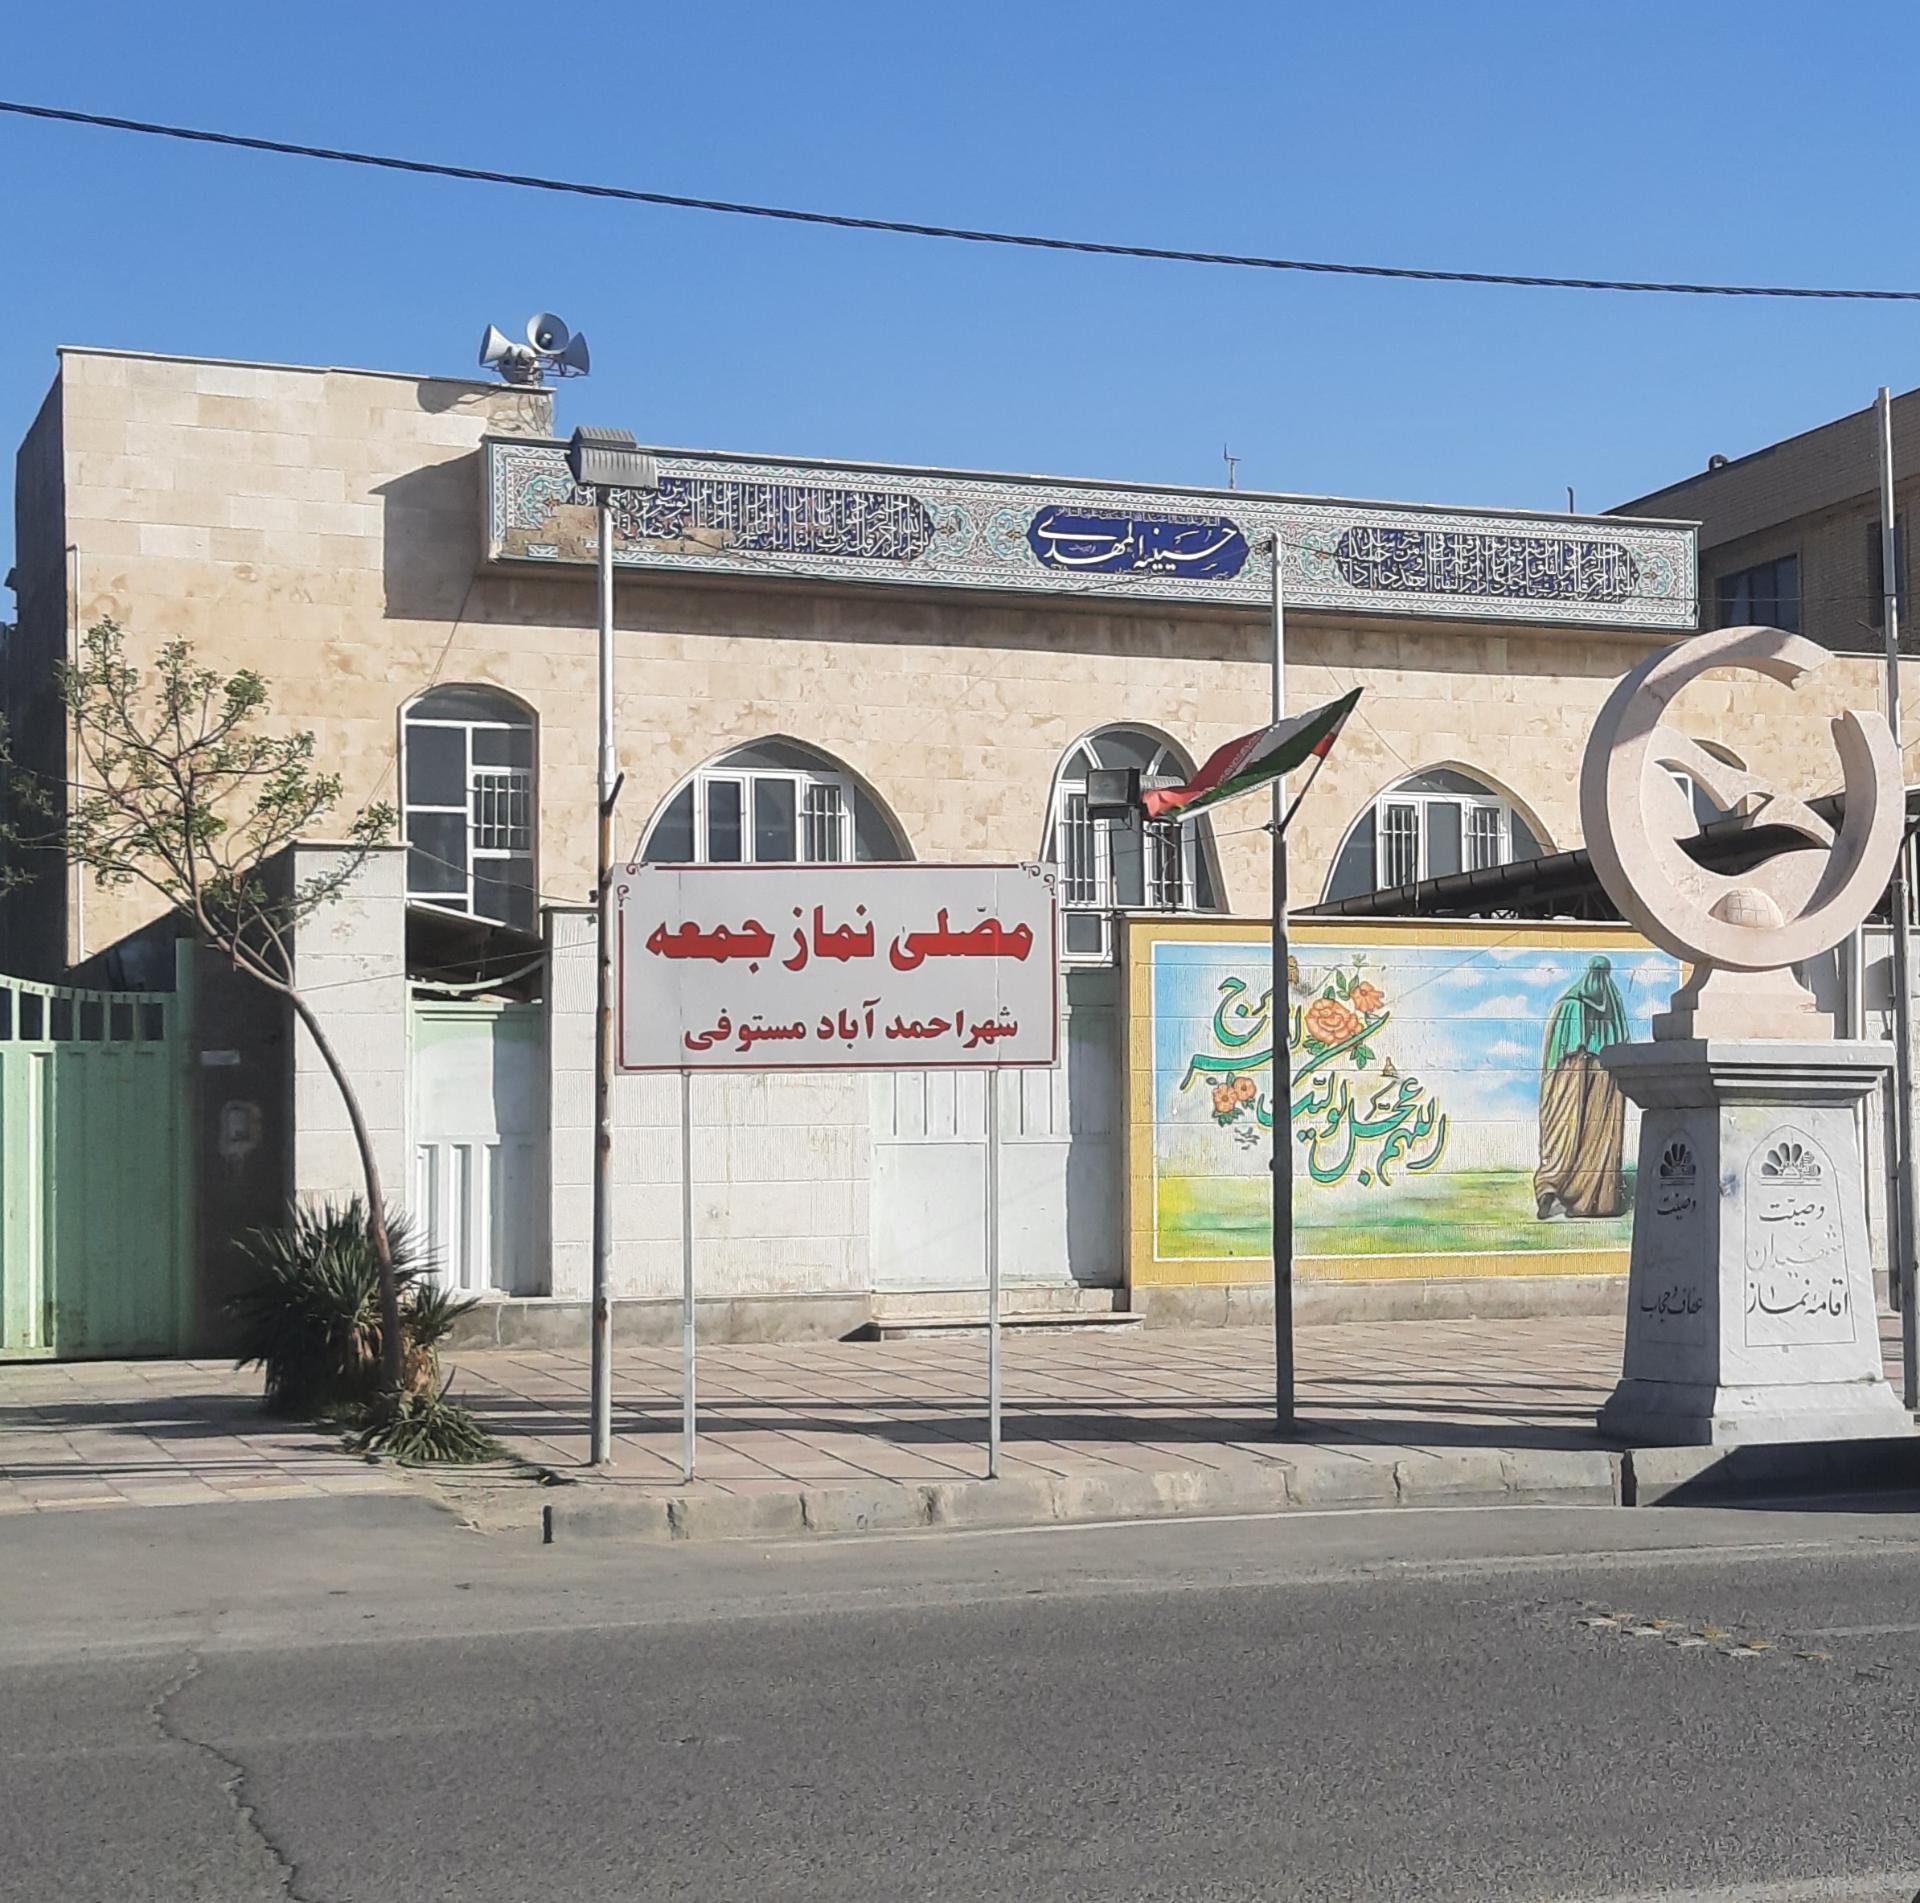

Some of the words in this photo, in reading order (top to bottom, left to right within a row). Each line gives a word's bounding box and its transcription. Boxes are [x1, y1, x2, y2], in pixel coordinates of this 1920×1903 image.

[645, 915, 776, 974] جمعه
[782, 903, 876, 972] نماز
[683, 1007, 807, 1052] مستوفی
[816, 996, 883, 1050] آباد
[885, 1008, 965, 1040] احمد
[962, 1005, 1019, 1049] شهر
